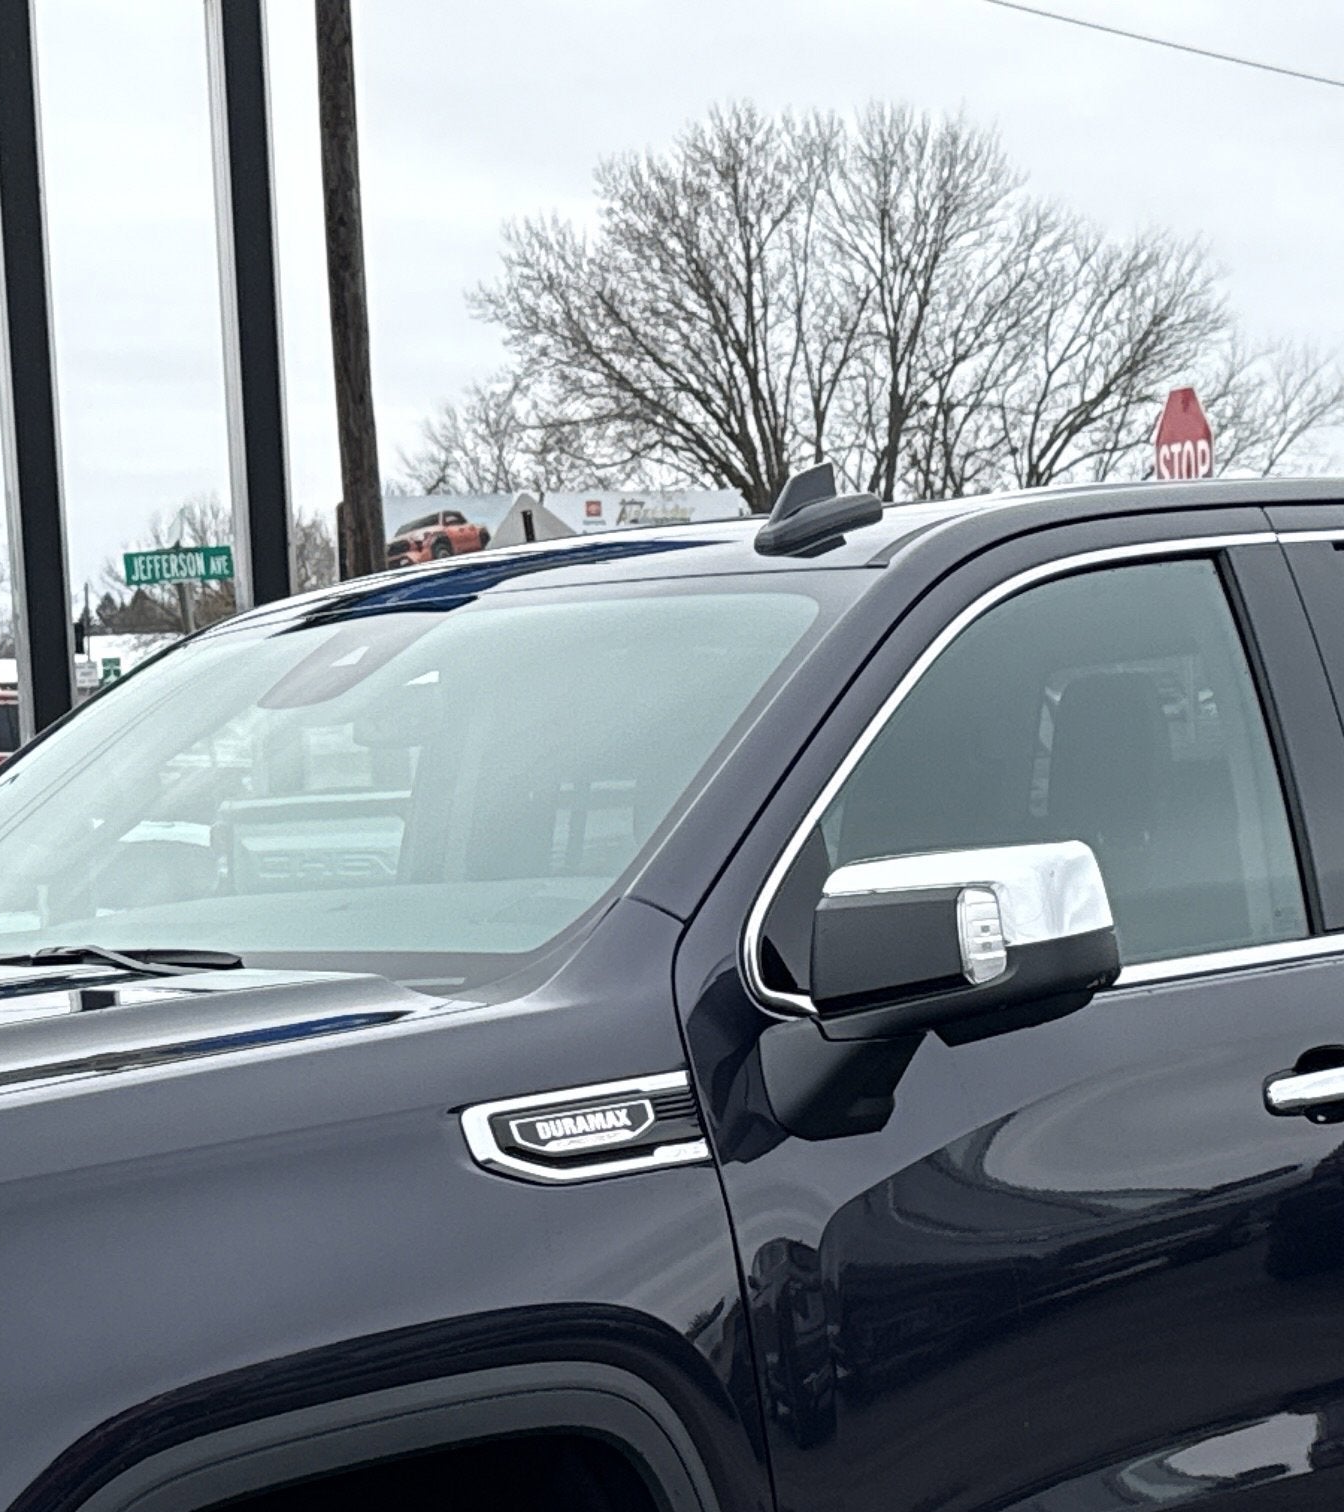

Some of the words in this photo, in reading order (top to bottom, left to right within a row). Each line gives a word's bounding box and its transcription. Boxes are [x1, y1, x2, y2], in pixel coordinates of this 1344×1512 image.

[1159, 439, 1211, 479] STOP
[131, 551, 206, 581] JEFFERSON
[210, 555, 230, 575] AVE
[535, 1107, 633, 1140] DURAMAX
